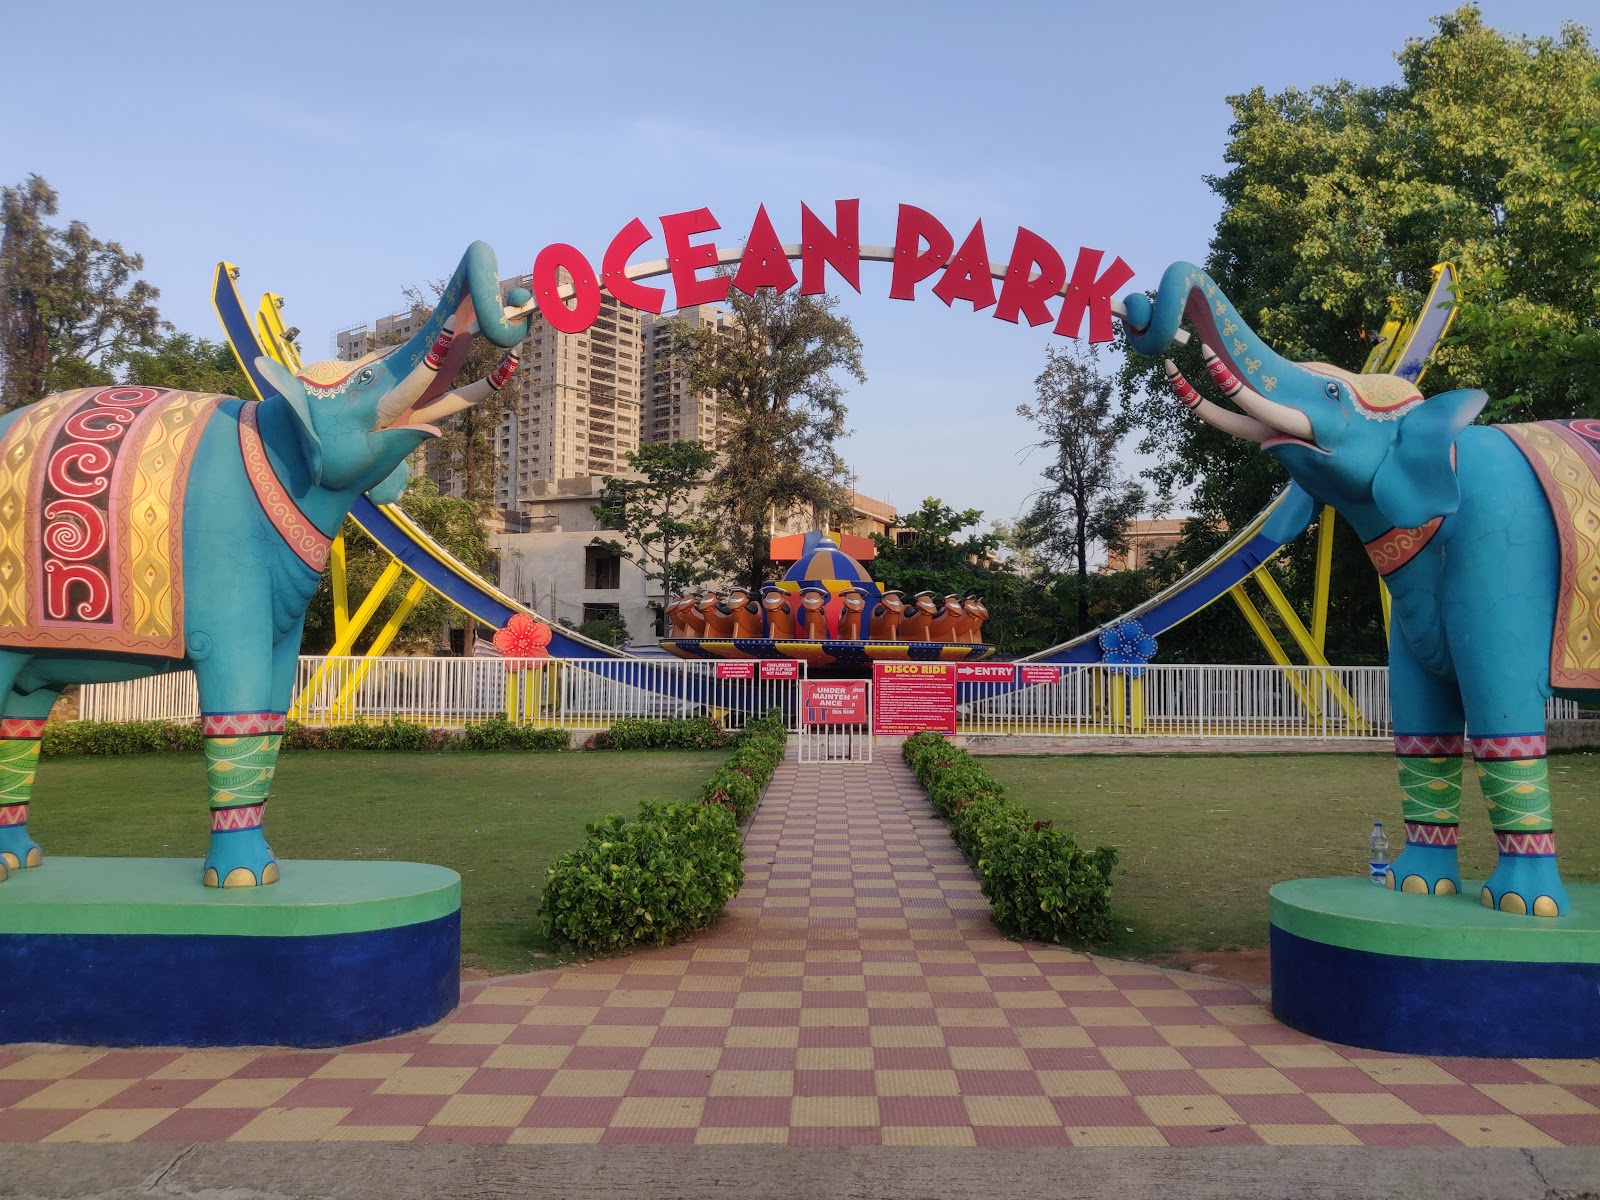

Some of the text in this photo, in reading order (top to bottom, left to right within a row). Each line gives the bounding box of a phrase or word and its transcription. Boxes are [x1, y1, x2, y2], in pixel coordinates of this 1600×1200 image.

[532, 198, 1136, 344] OCEAN PARK
[884, 665, 947, 674] DISCO RIDE
[974, 667, 1013, 676] ENTRY
